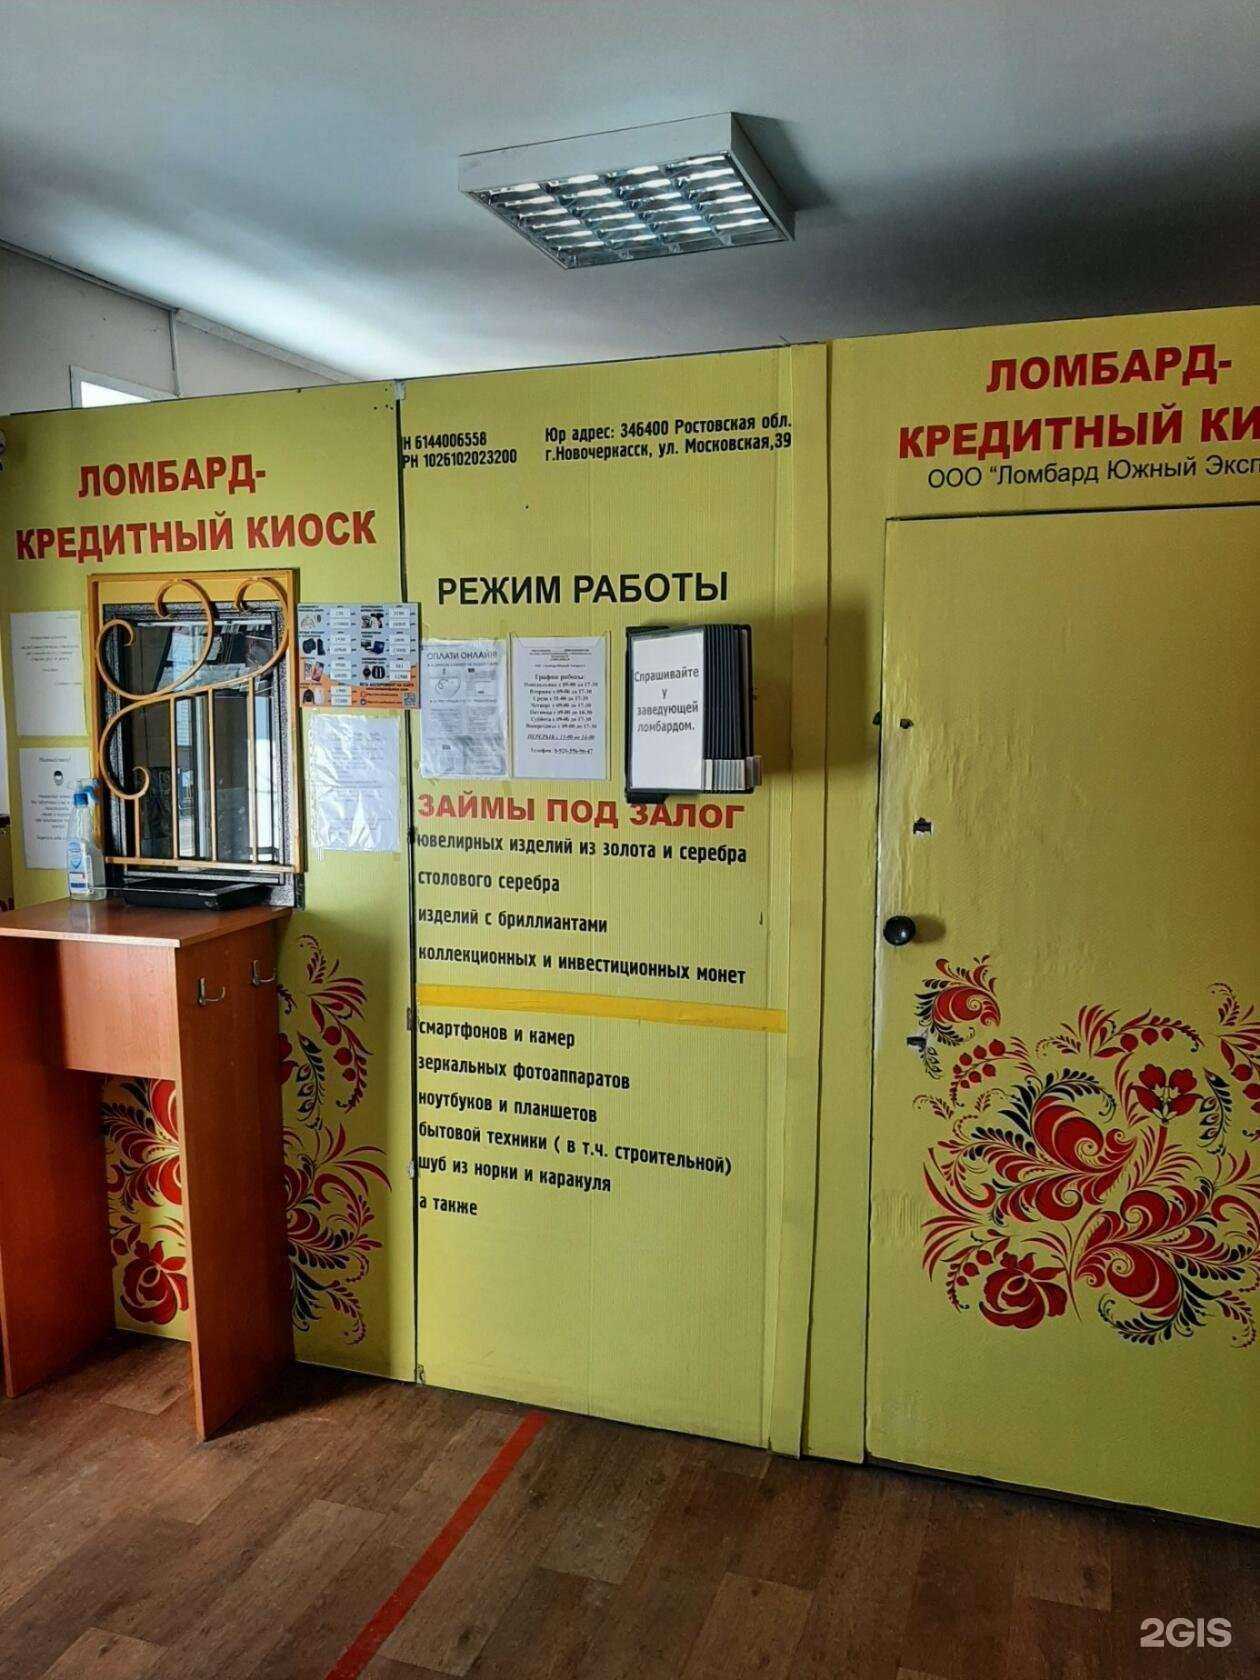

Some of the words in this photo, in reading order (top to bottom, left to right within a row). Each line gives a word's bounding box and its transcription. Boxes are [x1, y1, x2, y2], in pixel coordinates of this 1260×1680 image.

[986, 344, 1232, 392] ЛОМБАРД-
[415, 431, 487, 449] 6144006558
[545, 427, 566, 445] Юр
[571, 425, 615, 443] адрес:
[620, 420, 669, 437] 346400
[674, 415, 755, 434] Ростовская
[761, 413, 792, 428] обл.
[899, 402, 1183, 461] КРЕДИТНЫЙ
[423, 449, 517, 467] 1026102023200
[545, 443, 653, 462] г.Новочеркасск,
[658, 439, 679, 458] ул.
[684, 432, 792, 454] Московская,39
[79, 454, 265, 497] ЛОМБАРД-
[928, 467, 982, 488] ООО
[1107, 456, 1196, 481] Южный
[16, 510, 234, 563] КРЕДИТНЫЙ
[247, 510, 376, 549] КИОСК
[438, 575, 561, 605] РЕЖИМ
[574, 571, 728, 603] РАБОТЫ
[634, 666, 699, 684] Спрашивайте
[637, 701, 699, 716] заведующей
[662, 687, 668, 699] у
[637, 723, 695, 733] ломбардом.
[418, 791, 535, 821] ЗАЙМЫ
[547, 798, 618, 829] ПОД
[630, 801, 745, 829] ЗАЛОГ
[417, 833, 503, 852] ювелирных
[510, 838, 573, 855] изделий
[580, 842, 596, 855] из
[603, 843, 656, 858] золота
[663, 846, 673, 859] и
[680, 844, 747, 864] серебра
[418, 870, 492, 888] столового
[499, 875, 560, 894] серебра
[418, 907, 478, 925] изделий
[485, 913, 492, 925] с
[499, 911, 608, 933] бриллиантами
[418, 945, 536, 967] коллекционных
[543, 955, 552, 968] и
[558, 956, 690, 980] инвестиционных
[697, 967, 746, 984] монет
[419, 1020, 507, 1041] смартфонов
[514, 1028, 523, 1041] и
[529, 1029, 575, 1049] камер
[418, 1056, 507, 1077] зеркальных
[513, 1062, 630, 1090] фотоаппаратов
[419, 1092, 492, 1112] ноутбуков
[499, 1100, 507, 1112] и
[514, 1102, 597, 1122] планшетов
[419, 1123, 481, 1143] бытовой
[487, 1131, 547, 1150] техники
[567, 1141, 575, 1153] в
[583, 1142, 608, 1158] т.ч.
[614, 1145, 732, 1176] строительной)
[419, 1155, 446, 1174] шуб
[453, 1161, 468, 1174] из
[475, 1162, 517, 1182] норки
[524, 1168, 533, 1182] и
[540, 1169, 611, 1192] каракуля
[419, 1197, 427, 1209] а
[433, 1197, 478, 1215] также
